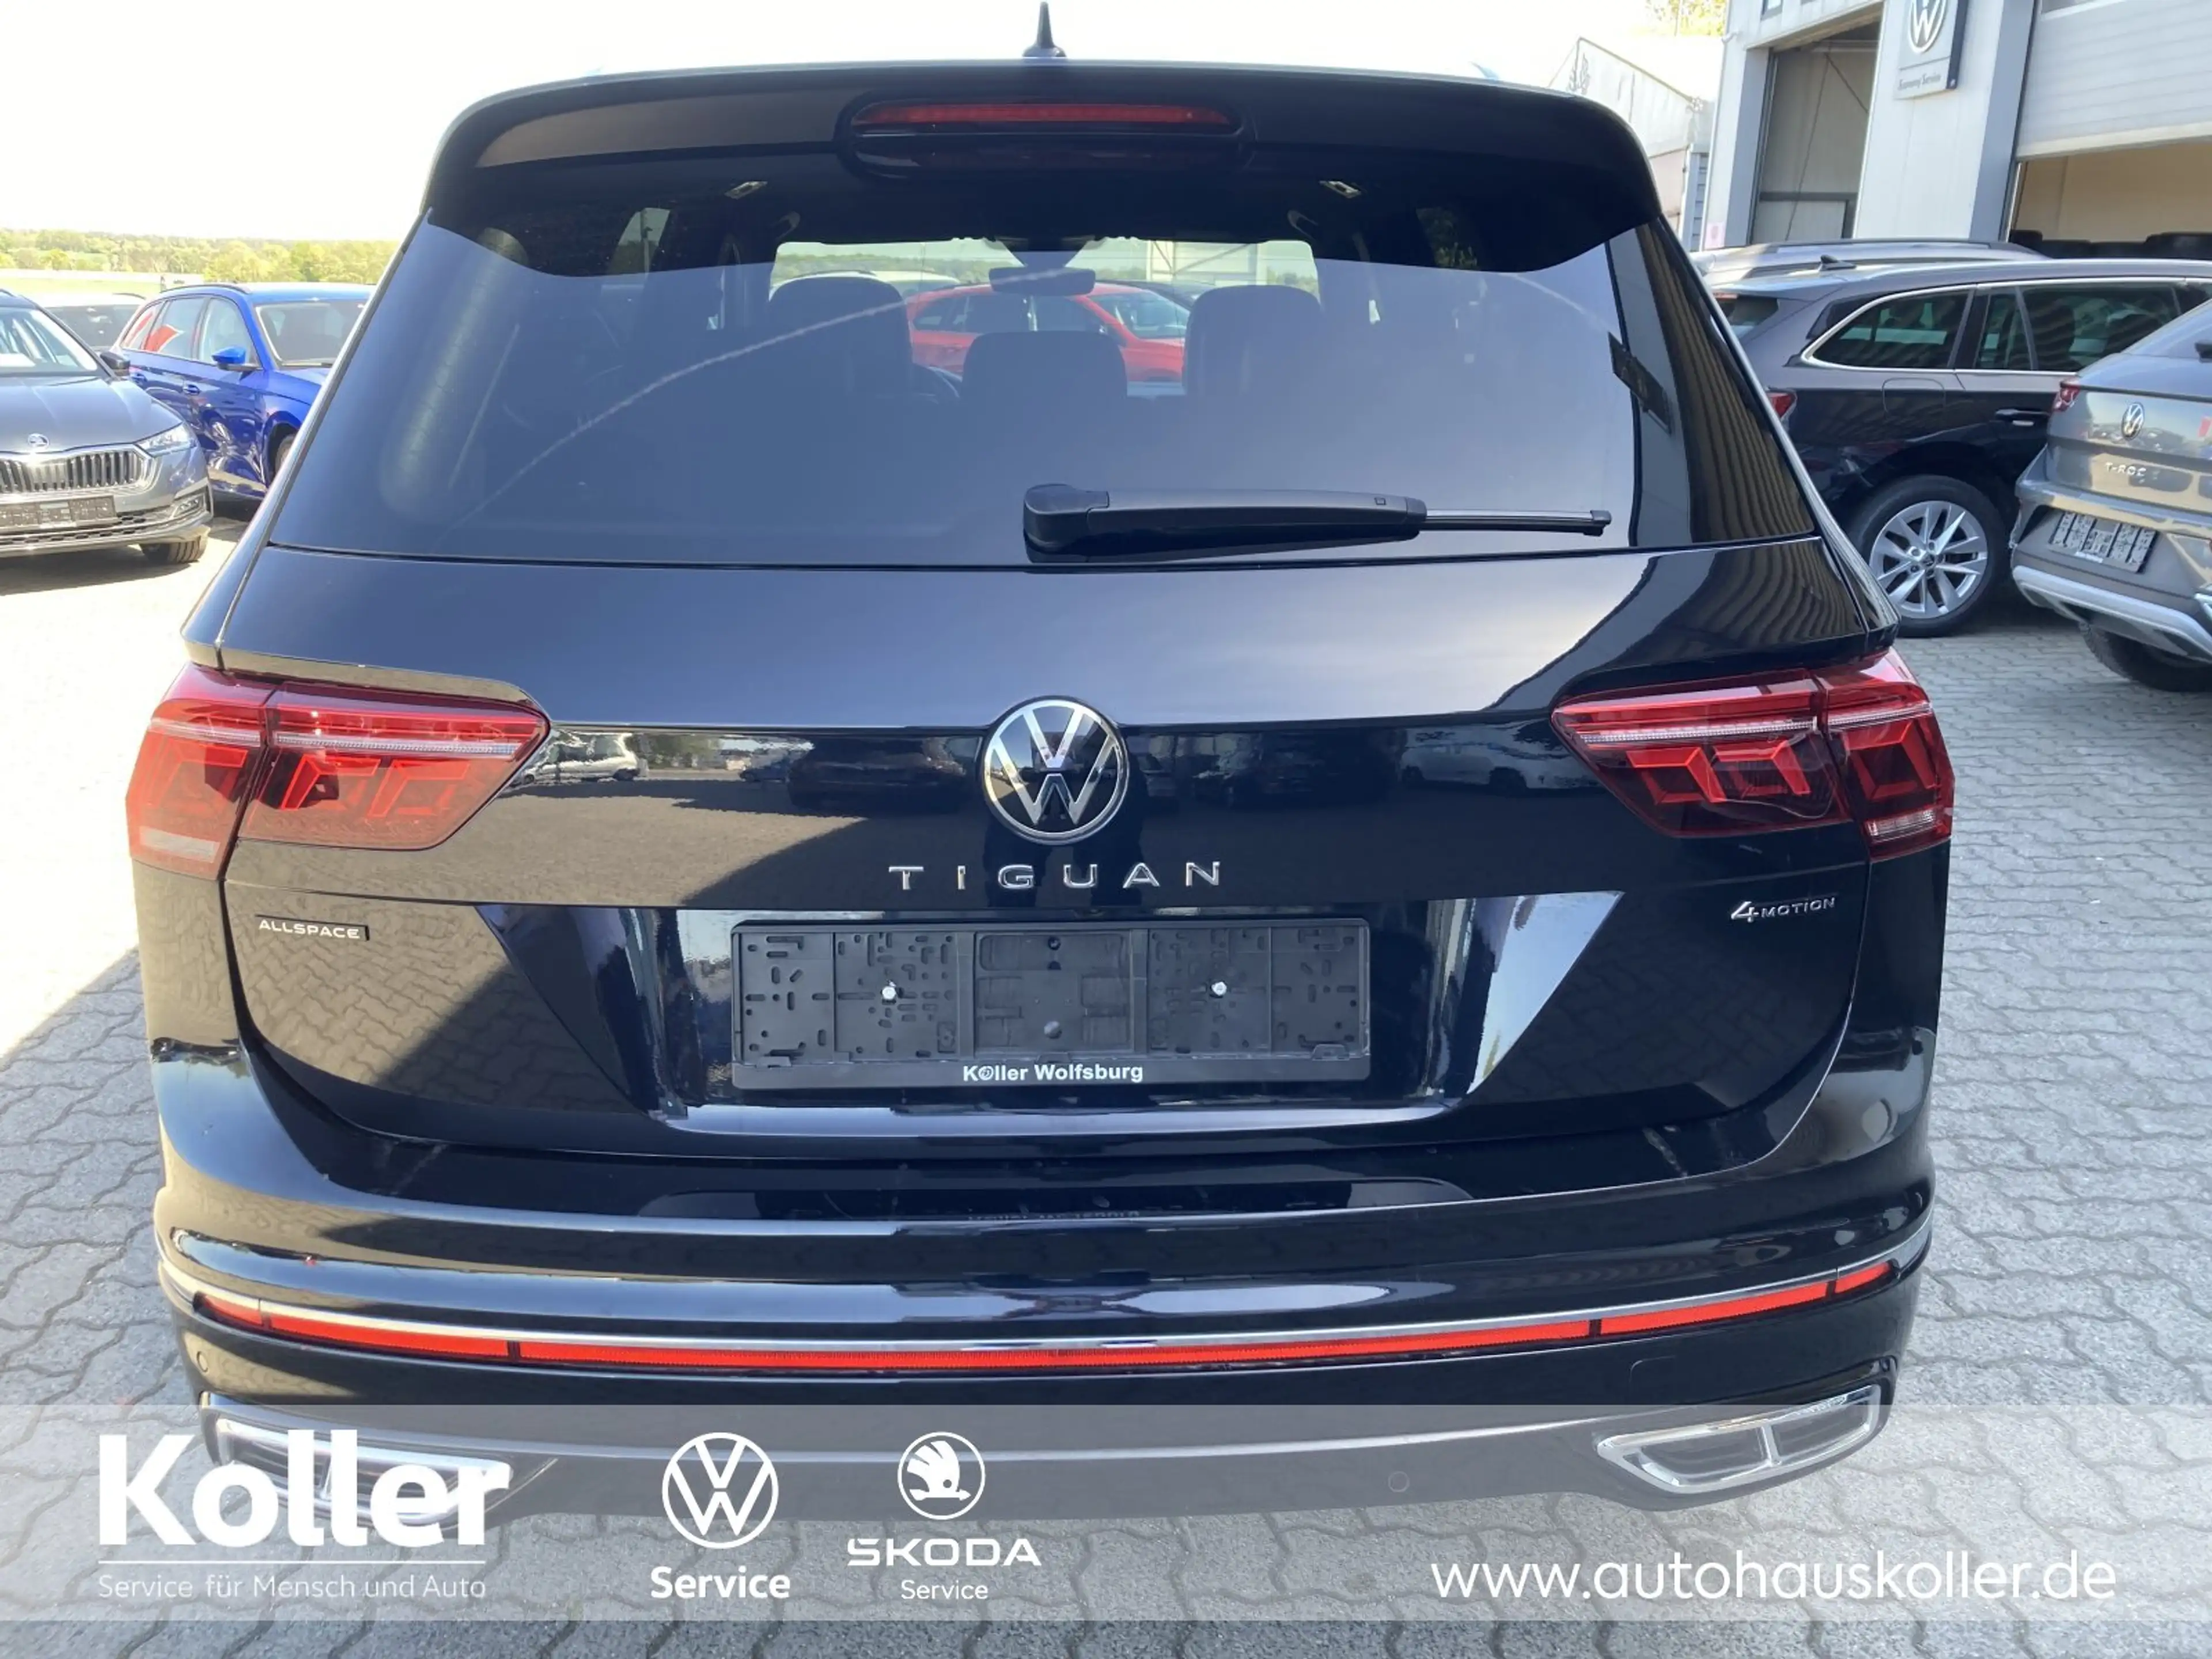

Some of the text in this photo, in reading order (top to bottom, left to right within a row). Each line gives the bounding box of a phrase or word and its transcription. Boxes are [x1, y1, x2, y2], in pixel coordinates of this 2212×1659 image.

[2105, 461, 2147, 476] T-ROC
[888, 861, 1220, 889] TIGUAN
[1730, 896, 1836, 923] 4MOTION
[259, 919, 360, 939] ALLSPACE
[963, 1063, 1143, 1083] Koller Wolfsburg
